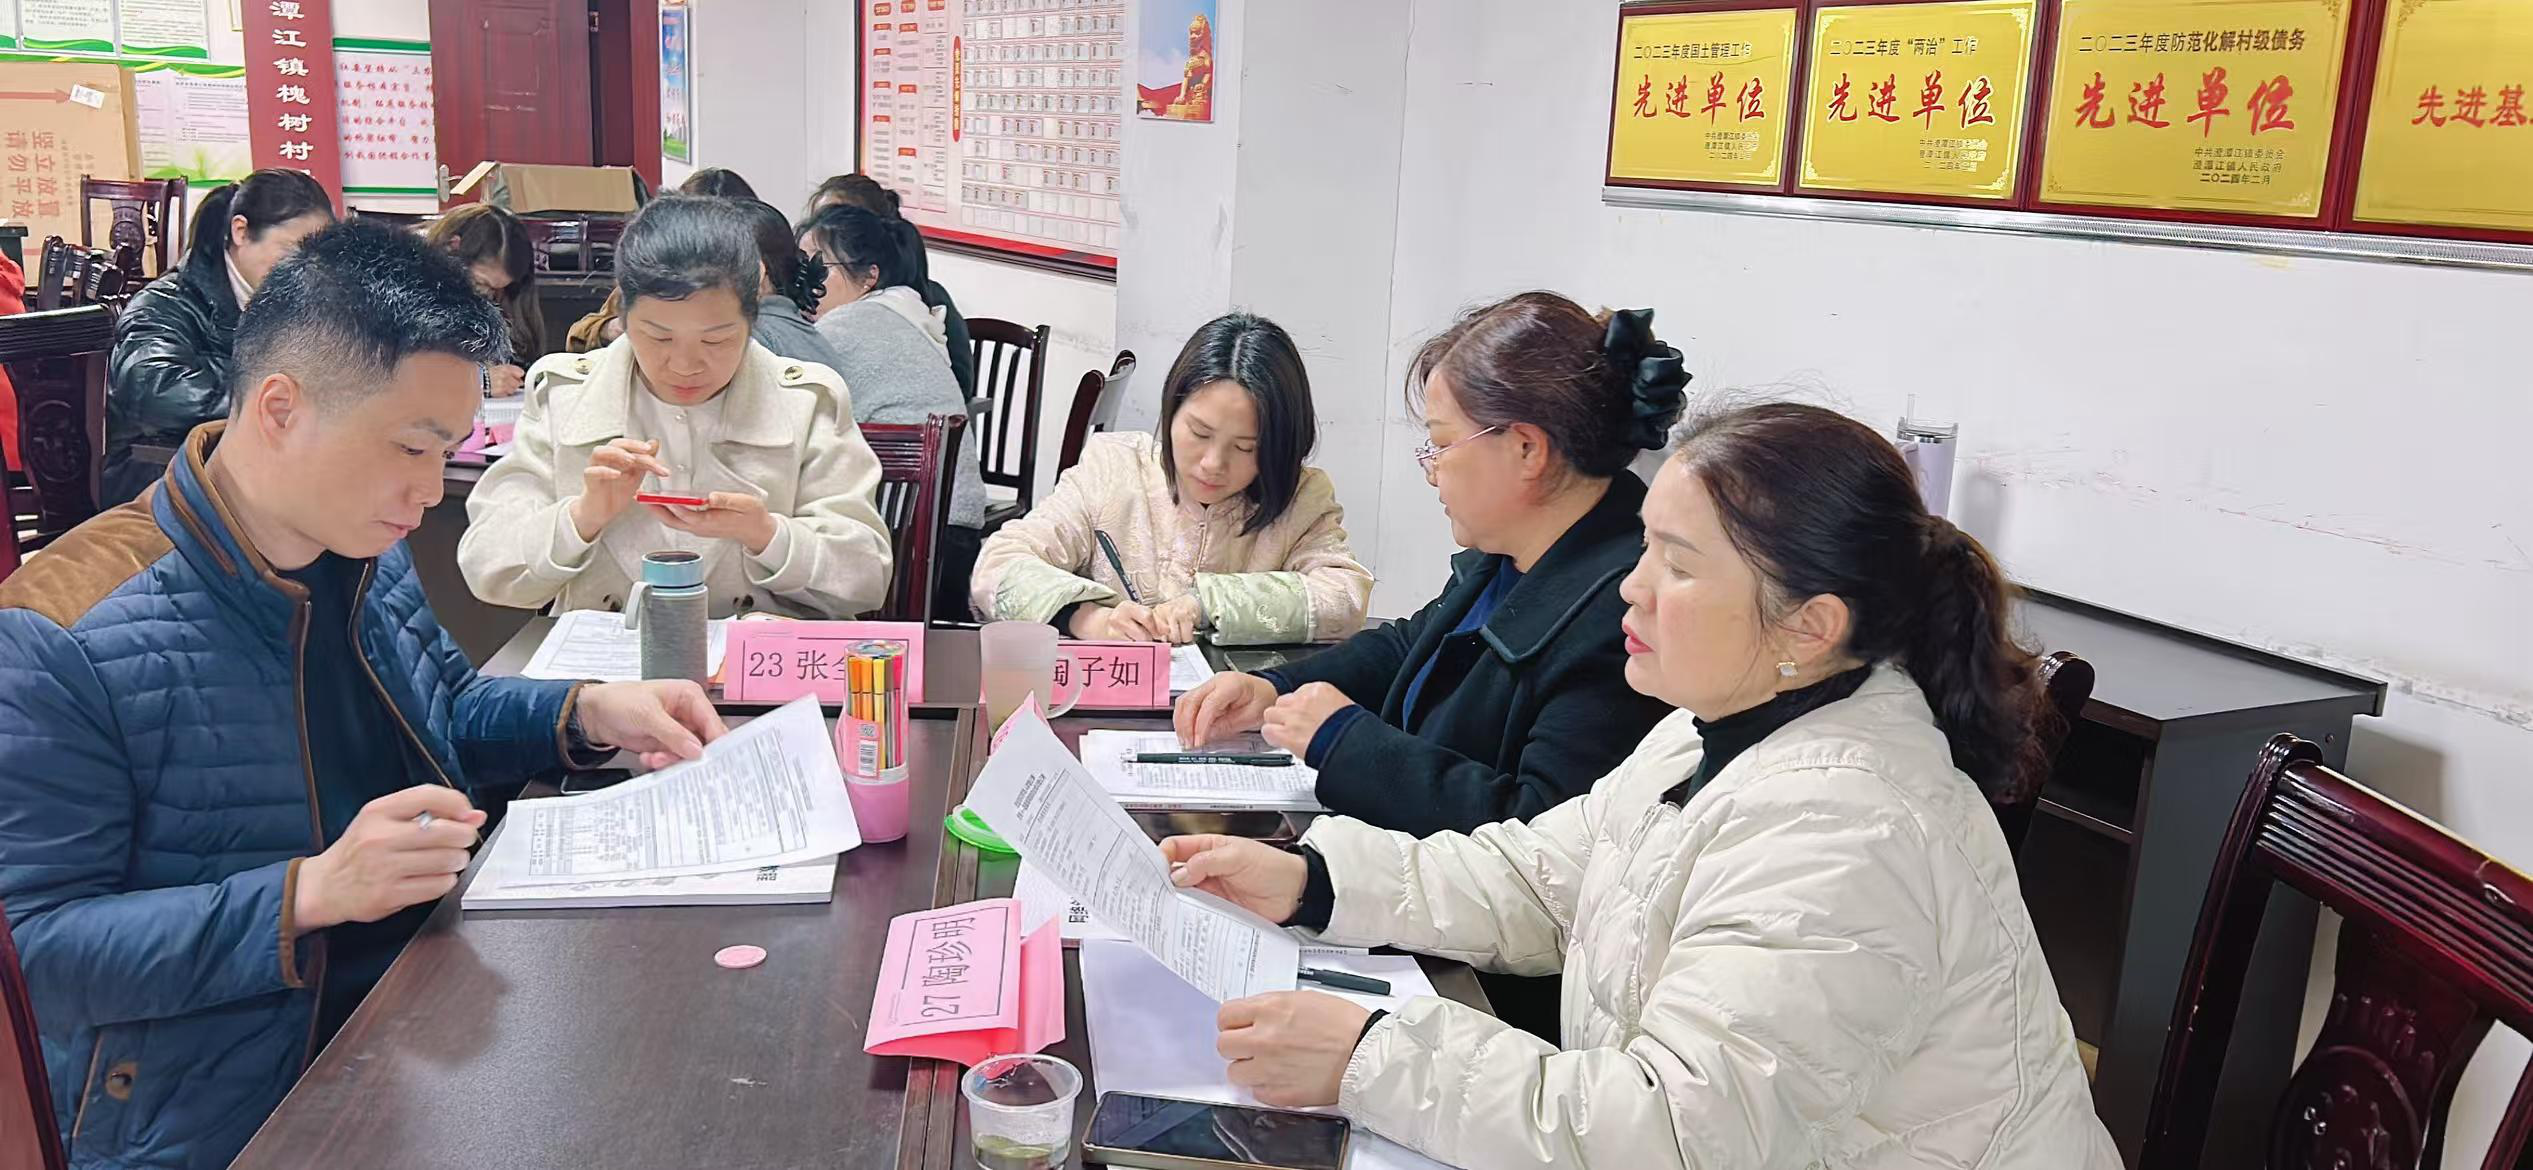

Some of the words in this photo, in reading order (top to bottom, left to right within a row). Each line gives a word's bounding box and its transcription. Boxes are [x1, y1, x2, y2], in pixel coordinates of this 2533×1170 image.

[269, 1, 316, 180] 潭江镇槐树村
[1633, 71, 1765, 126] 先进单位
[1828, 70, 1994, 130] 先进单位
[2075, 66, 2295, 138] 先进单位
[2411, 84, 2533, 128] 先进基
[7, 131, 34, 219] 请勿平放
[749, 652, 783, 678] 23
[922, 916, 976, 988] 陶珍明
[921, 995, 961, 1018] 27
